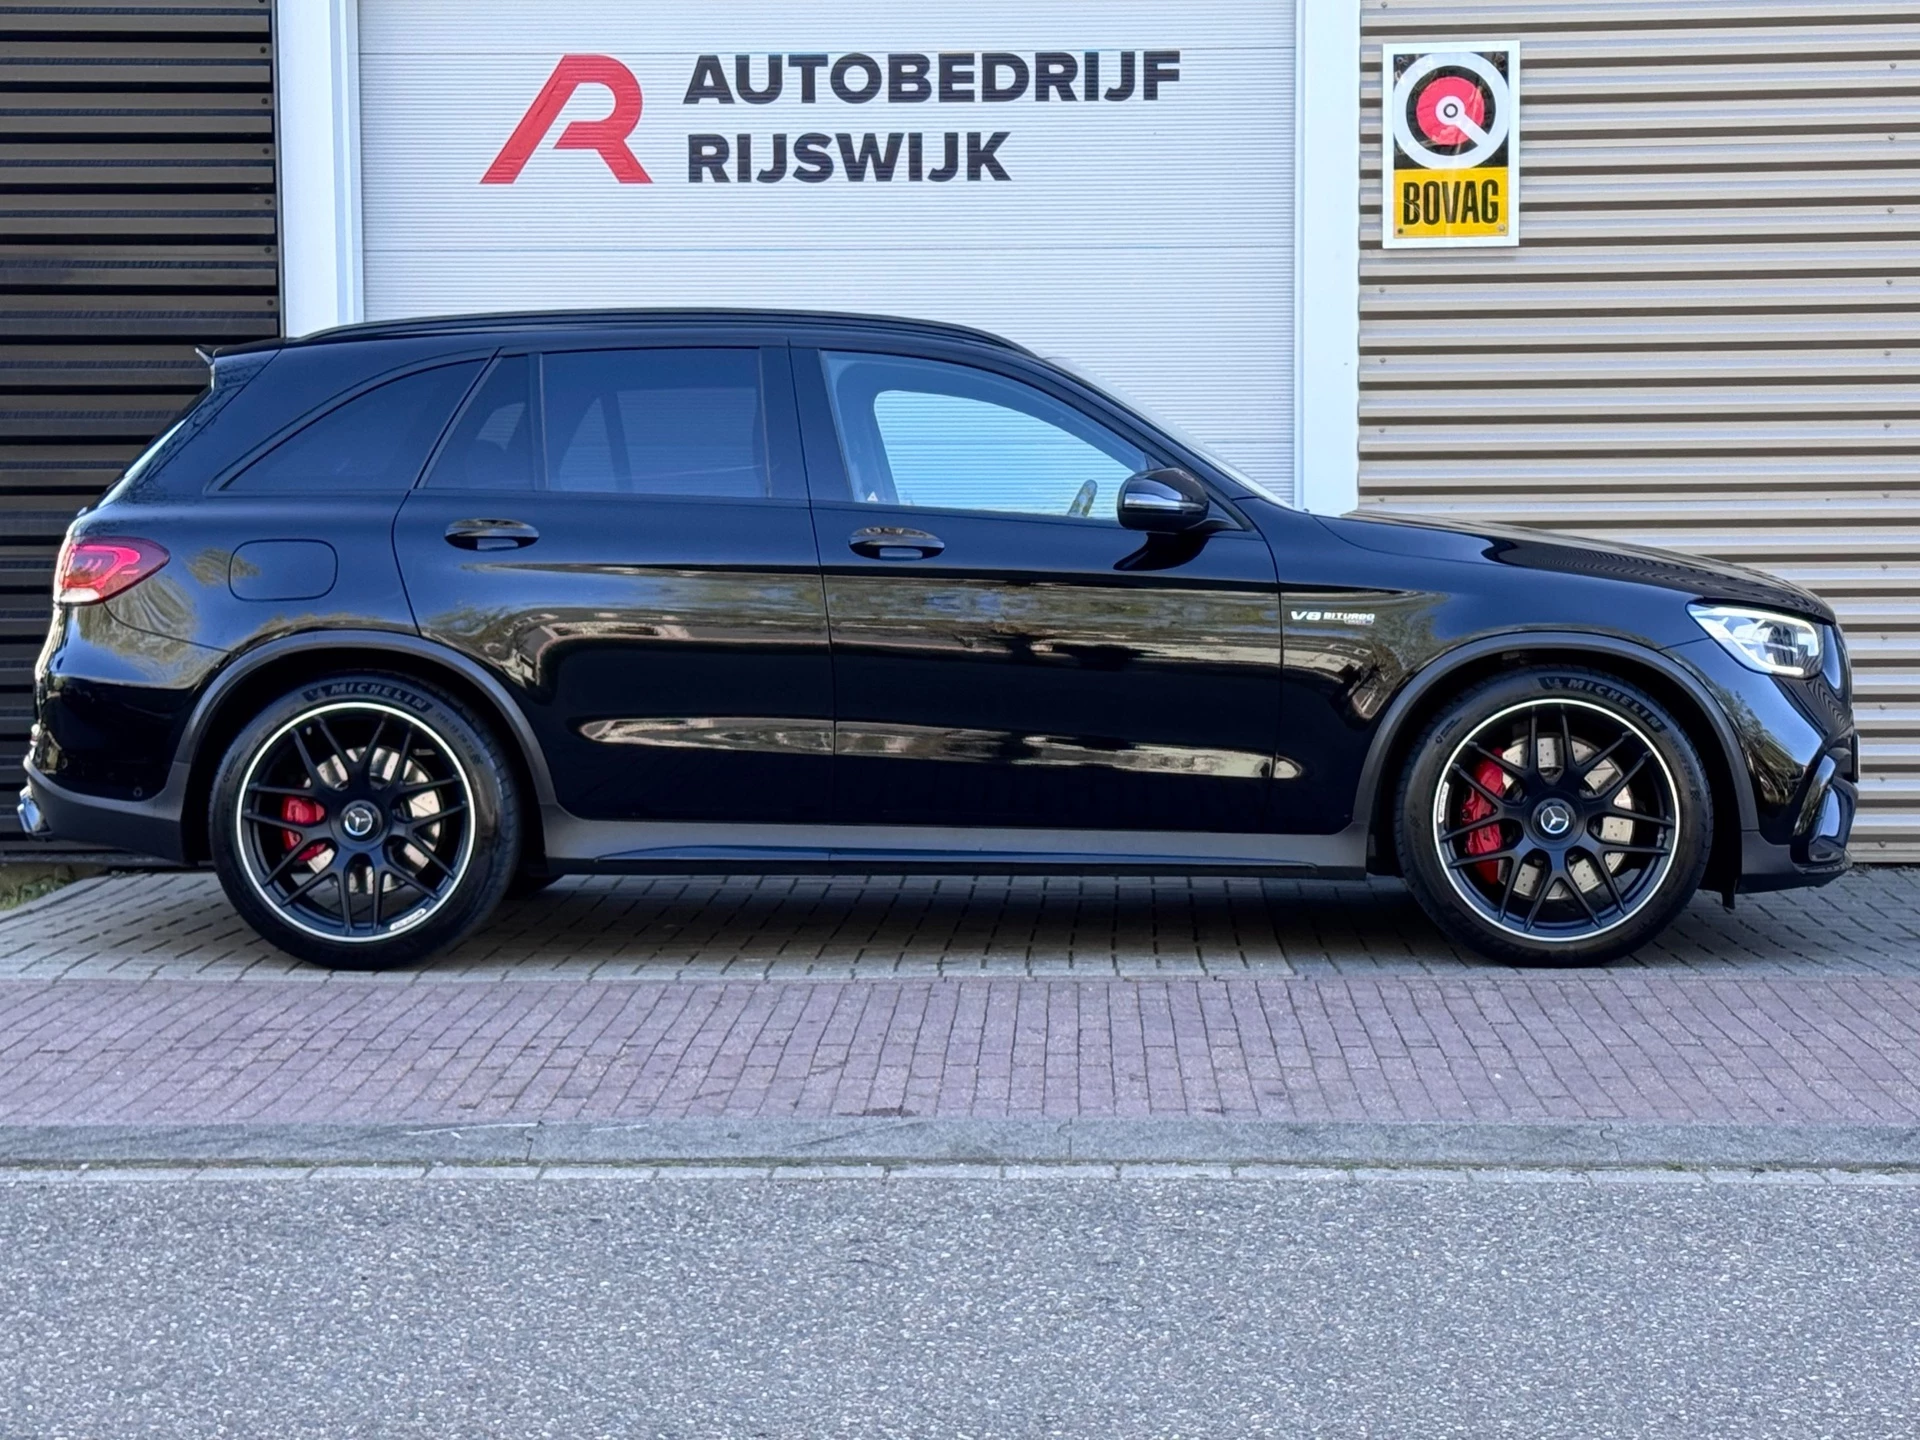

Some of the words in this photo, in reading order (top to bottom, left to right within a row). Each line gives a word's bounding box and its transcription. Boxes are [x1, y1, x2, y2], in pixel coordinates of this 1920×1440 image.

[682, 50, 1181, 104] AUTOBEDRIJF
[688, 131, 1012, 183] RIJSWIJK
[1403, 179, 1498, 225] BOVAG
[1290, 611, 1321, 621] V8
[1323, 612, 1375, 621] BITURBO
[330, 683, 427, 709] MICHELIN
[1568, 679, 1661, 729] MICHELIN
